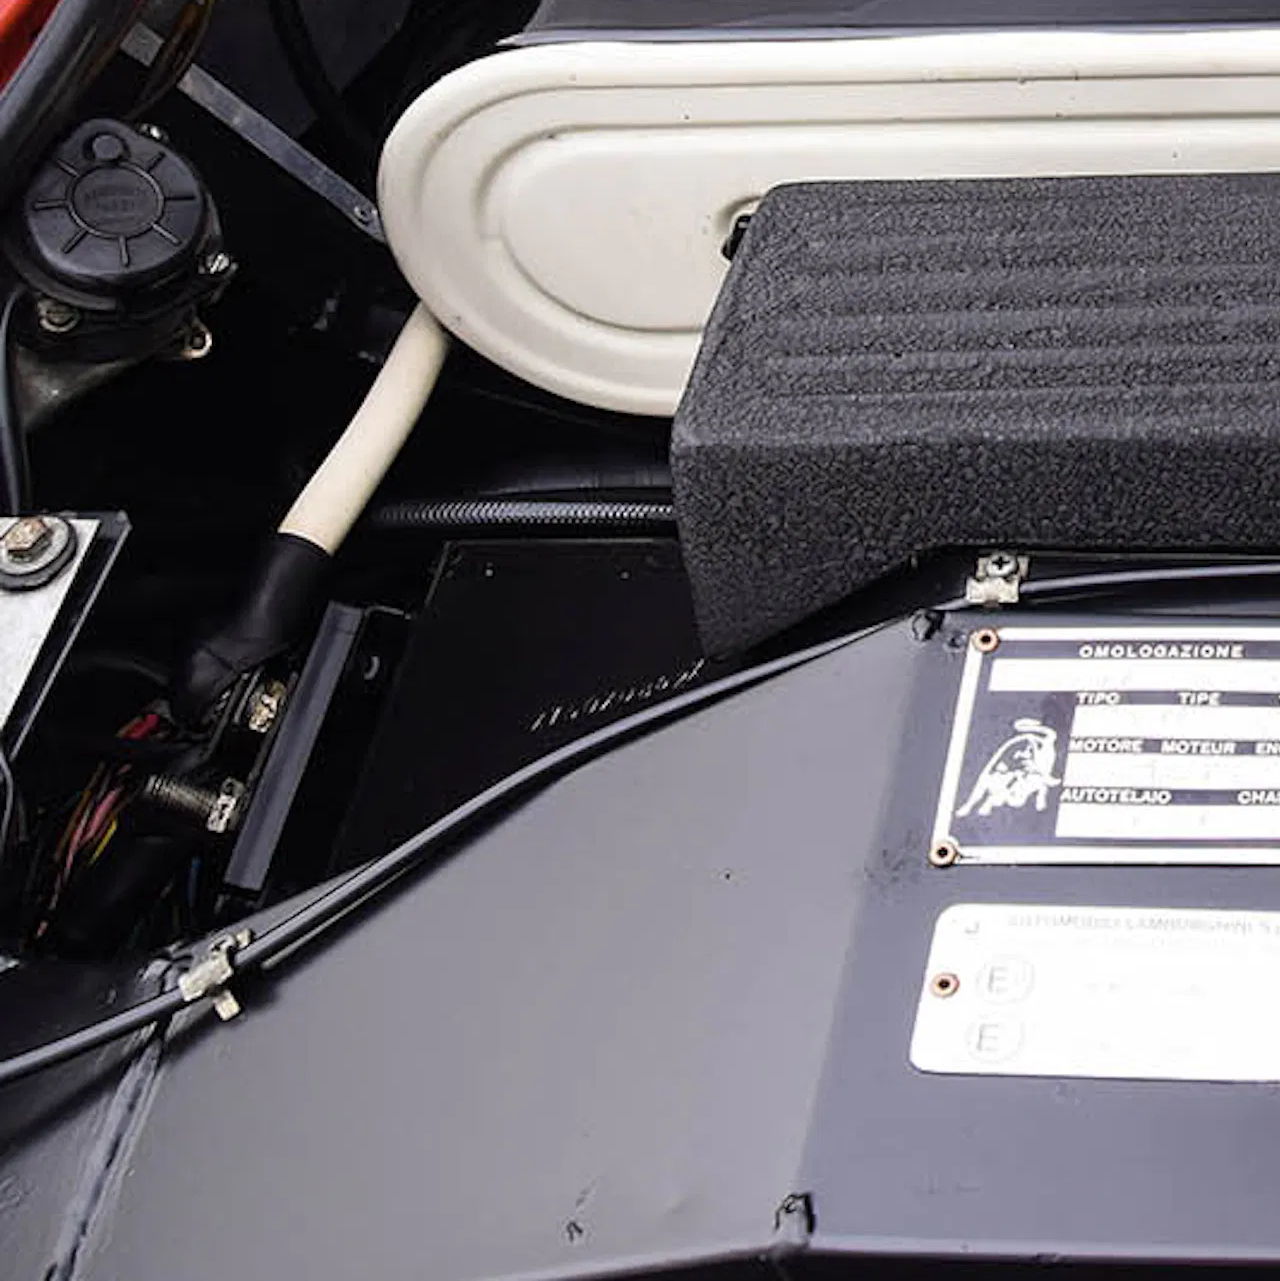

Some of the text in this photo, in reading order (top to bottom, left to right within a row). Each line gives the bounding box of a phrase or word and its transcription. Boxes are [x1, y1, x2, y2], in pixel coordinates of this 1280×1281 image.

[1078, 644, 1245, 659] OMOLOGAZIONE
[1076, 691, 1121, 706] TIPO
[1068, 738, 1144, 754] MOTORE
[1160, 739, 1237, 755] MOTEUR
[1059, 787, 1172, 804] AUTOTELAIO
